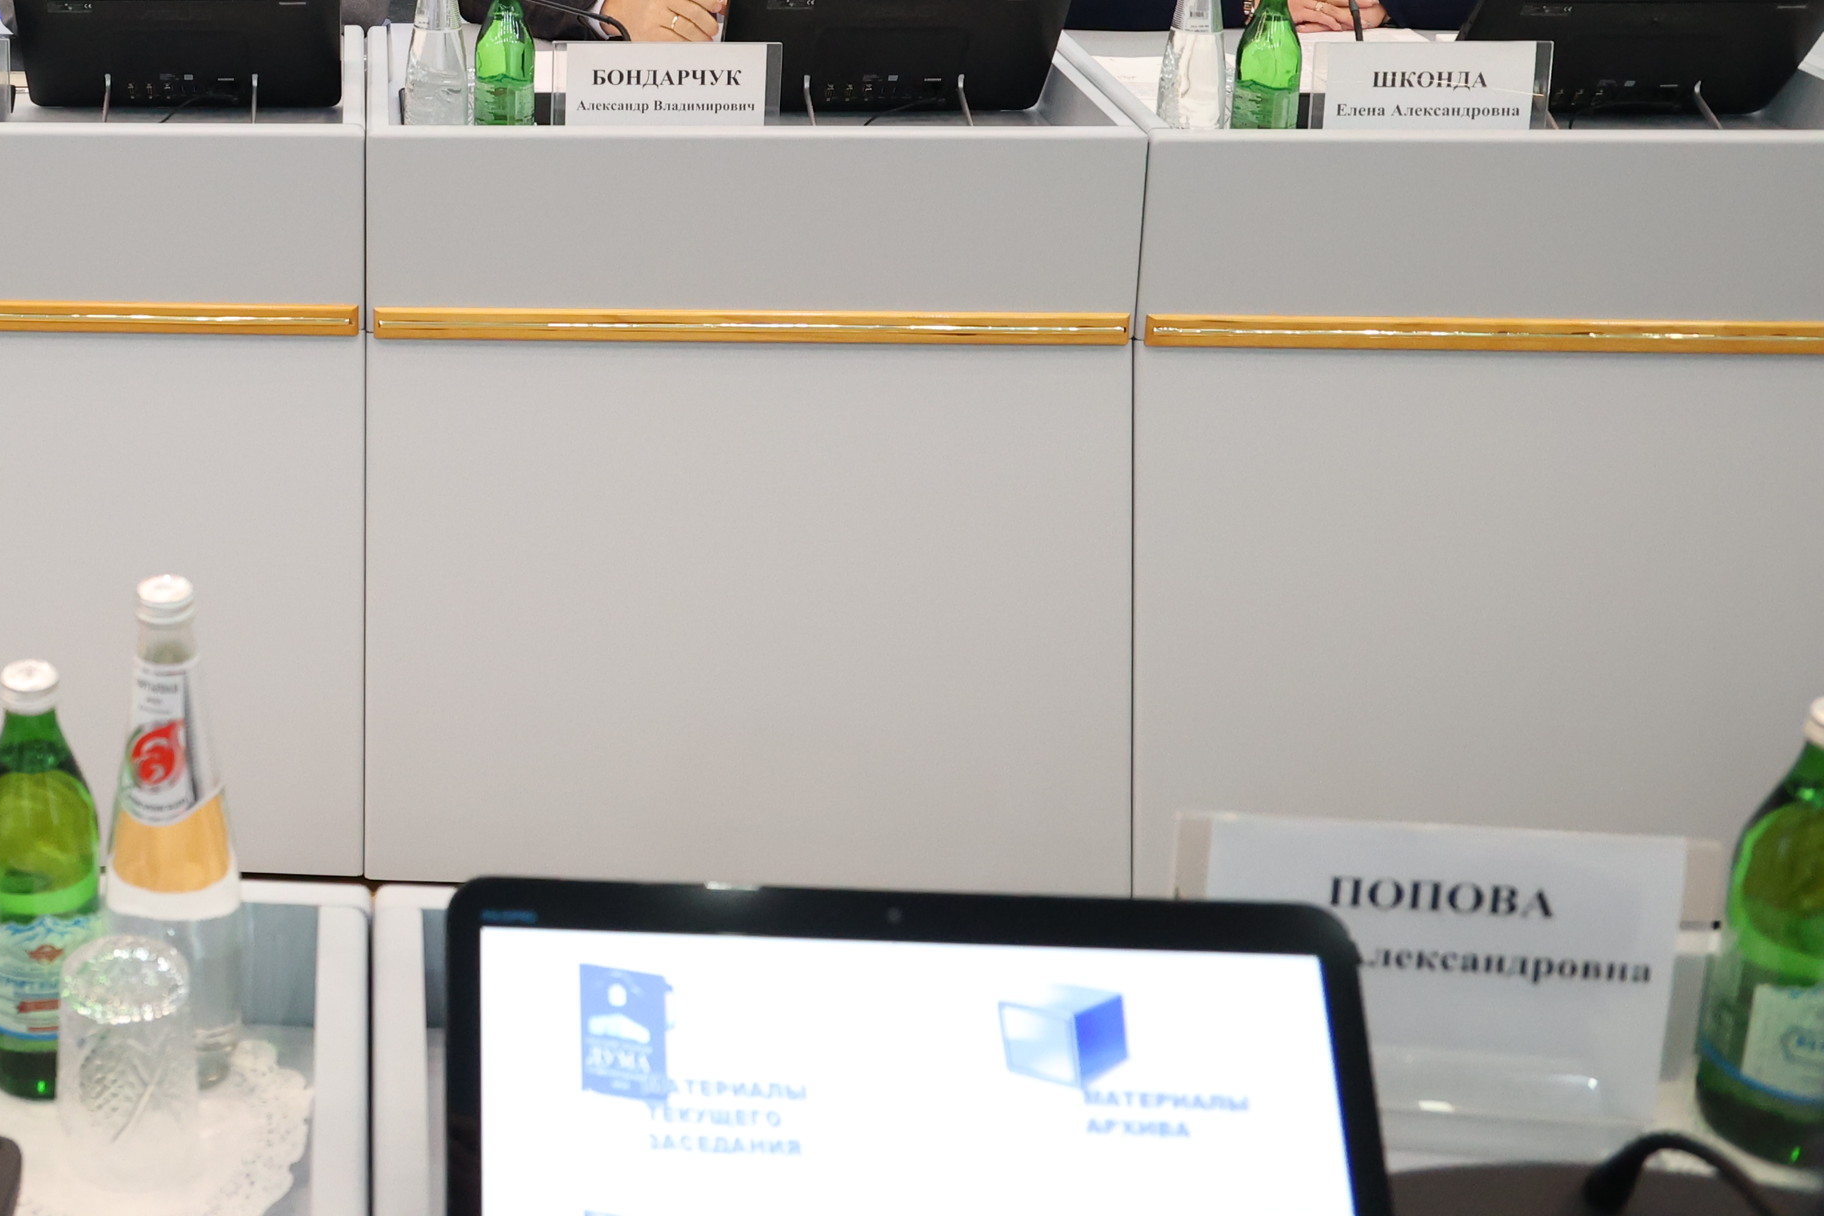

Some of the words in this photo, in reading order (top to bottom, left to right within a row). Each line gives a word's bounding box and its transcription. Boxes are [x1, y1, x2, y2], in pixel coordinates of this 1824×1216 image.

[591, 68, 743, 89] БОНДАРЧУК
[1371, 70, 1488, 92] ШКОНДА
[576, 99, 650, 114] Александр
[653, 99, 756, 114] Владимирович
[1335, 102, 1387, 118] Елена
[1392, 102, 1521, 121] Александровна
[1329, 875, 1555, 921] ПОПОВА
[1361, 947, 1653, 986] лександровна
[1086, 1117, 1192, 1138] АРХИВА
[649, 1134, 804, 1156] ЗАСЕДАНИЯ
